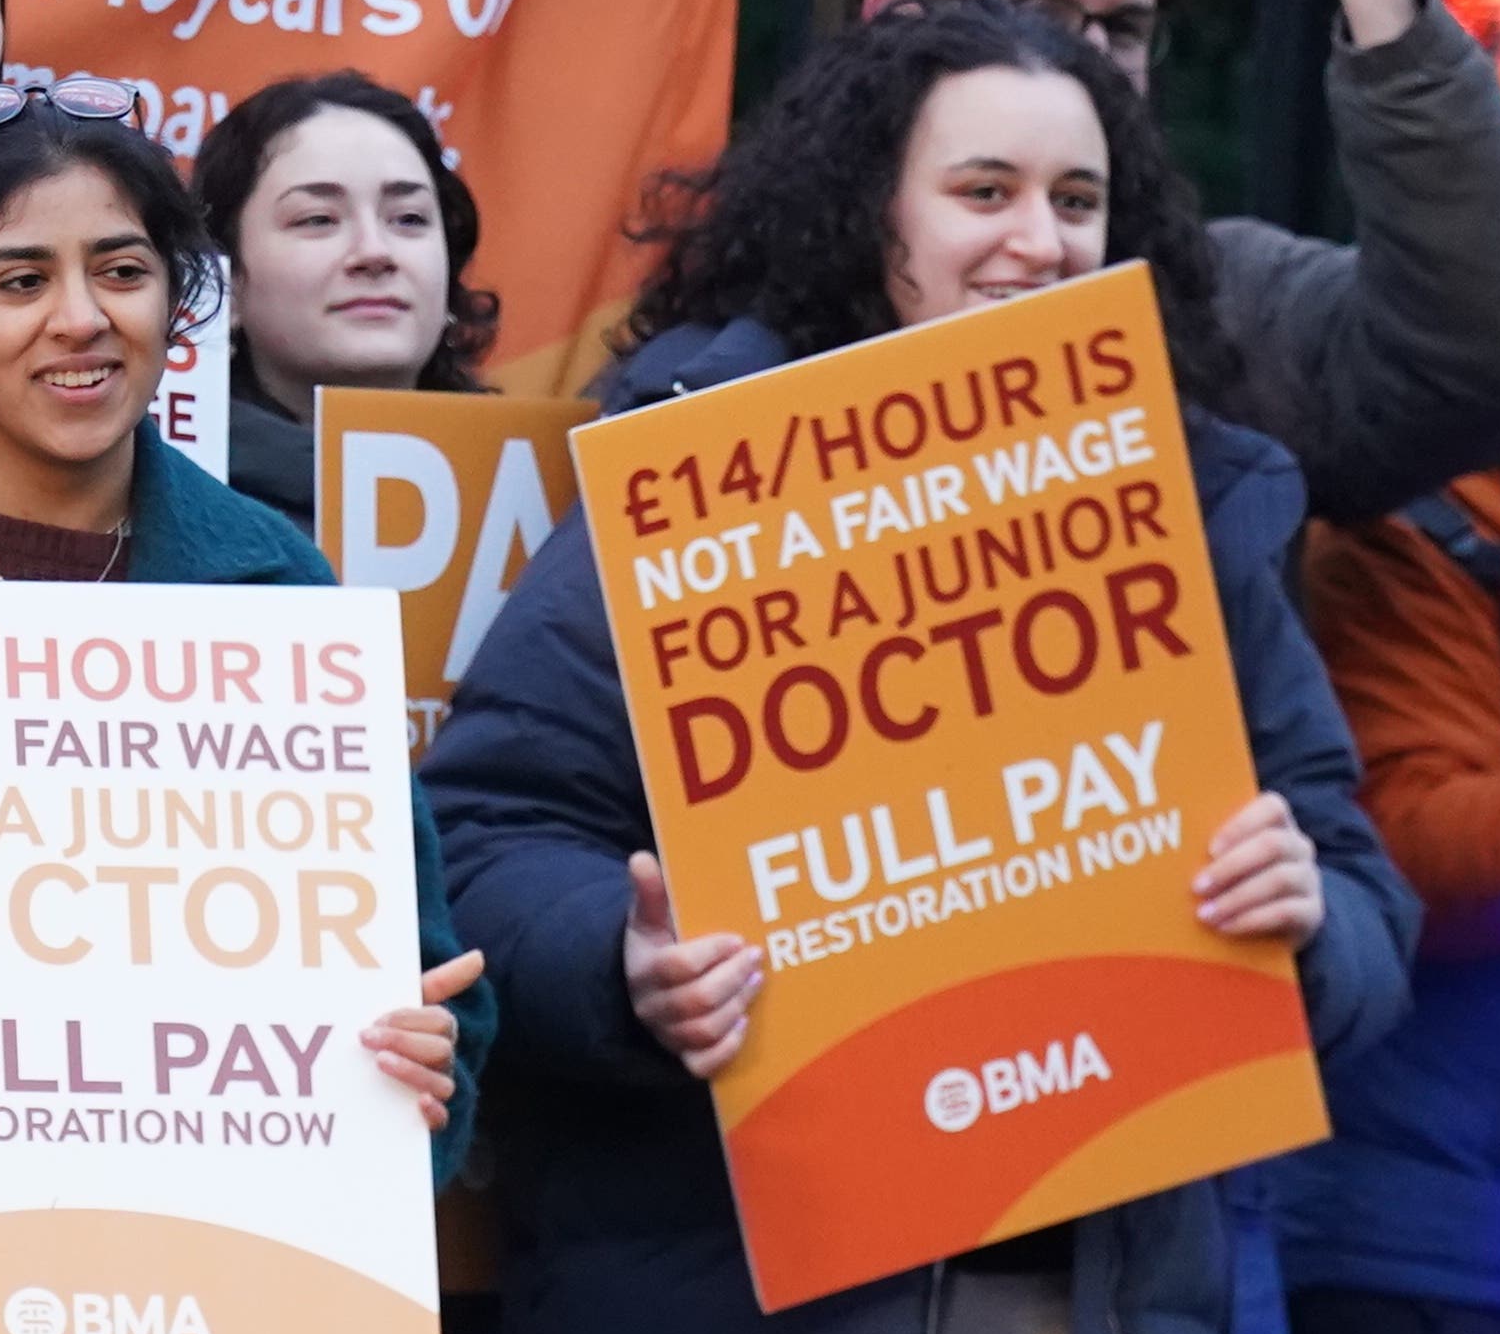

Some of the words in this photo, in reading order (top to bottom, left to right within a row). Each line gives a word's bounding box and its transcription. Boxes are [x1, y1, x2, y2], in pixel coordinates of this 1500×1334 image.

[624, 354, 1045, 538] £14/HOUR
[1064, 327, 1136, 406] IS
[632, 524, 766, 610] NOT
[777, 511, 824, 569] A
[832, 461, 970, 551] FAIR
[972, 407, 1154, 501] WAGE
[650, 590, 804, 689] FOR
[827, 570, 883, 637] A
[888, 479, 1169, 628] JUNIOR
[292, 642, 366, 707] IS
[666, 560, 1192, 808] DOCTOR
[14, 718, 159, 769] FAIR
[178, 722, 372, 773] WAGE
[64, 785, 375, 858] JUNIOR
[745, 788, 993, 922] FULL
[1001, 720, 1167, 853] PAY
[767, 858, 1076, 972] RESTORATION
[1079, 808, 1185, 876] NOW
[155, 1021, 334, 1098] PAY
[983, 1032, 1112, 1115] BMA
[222, 1110, 337, 1147] NOW
